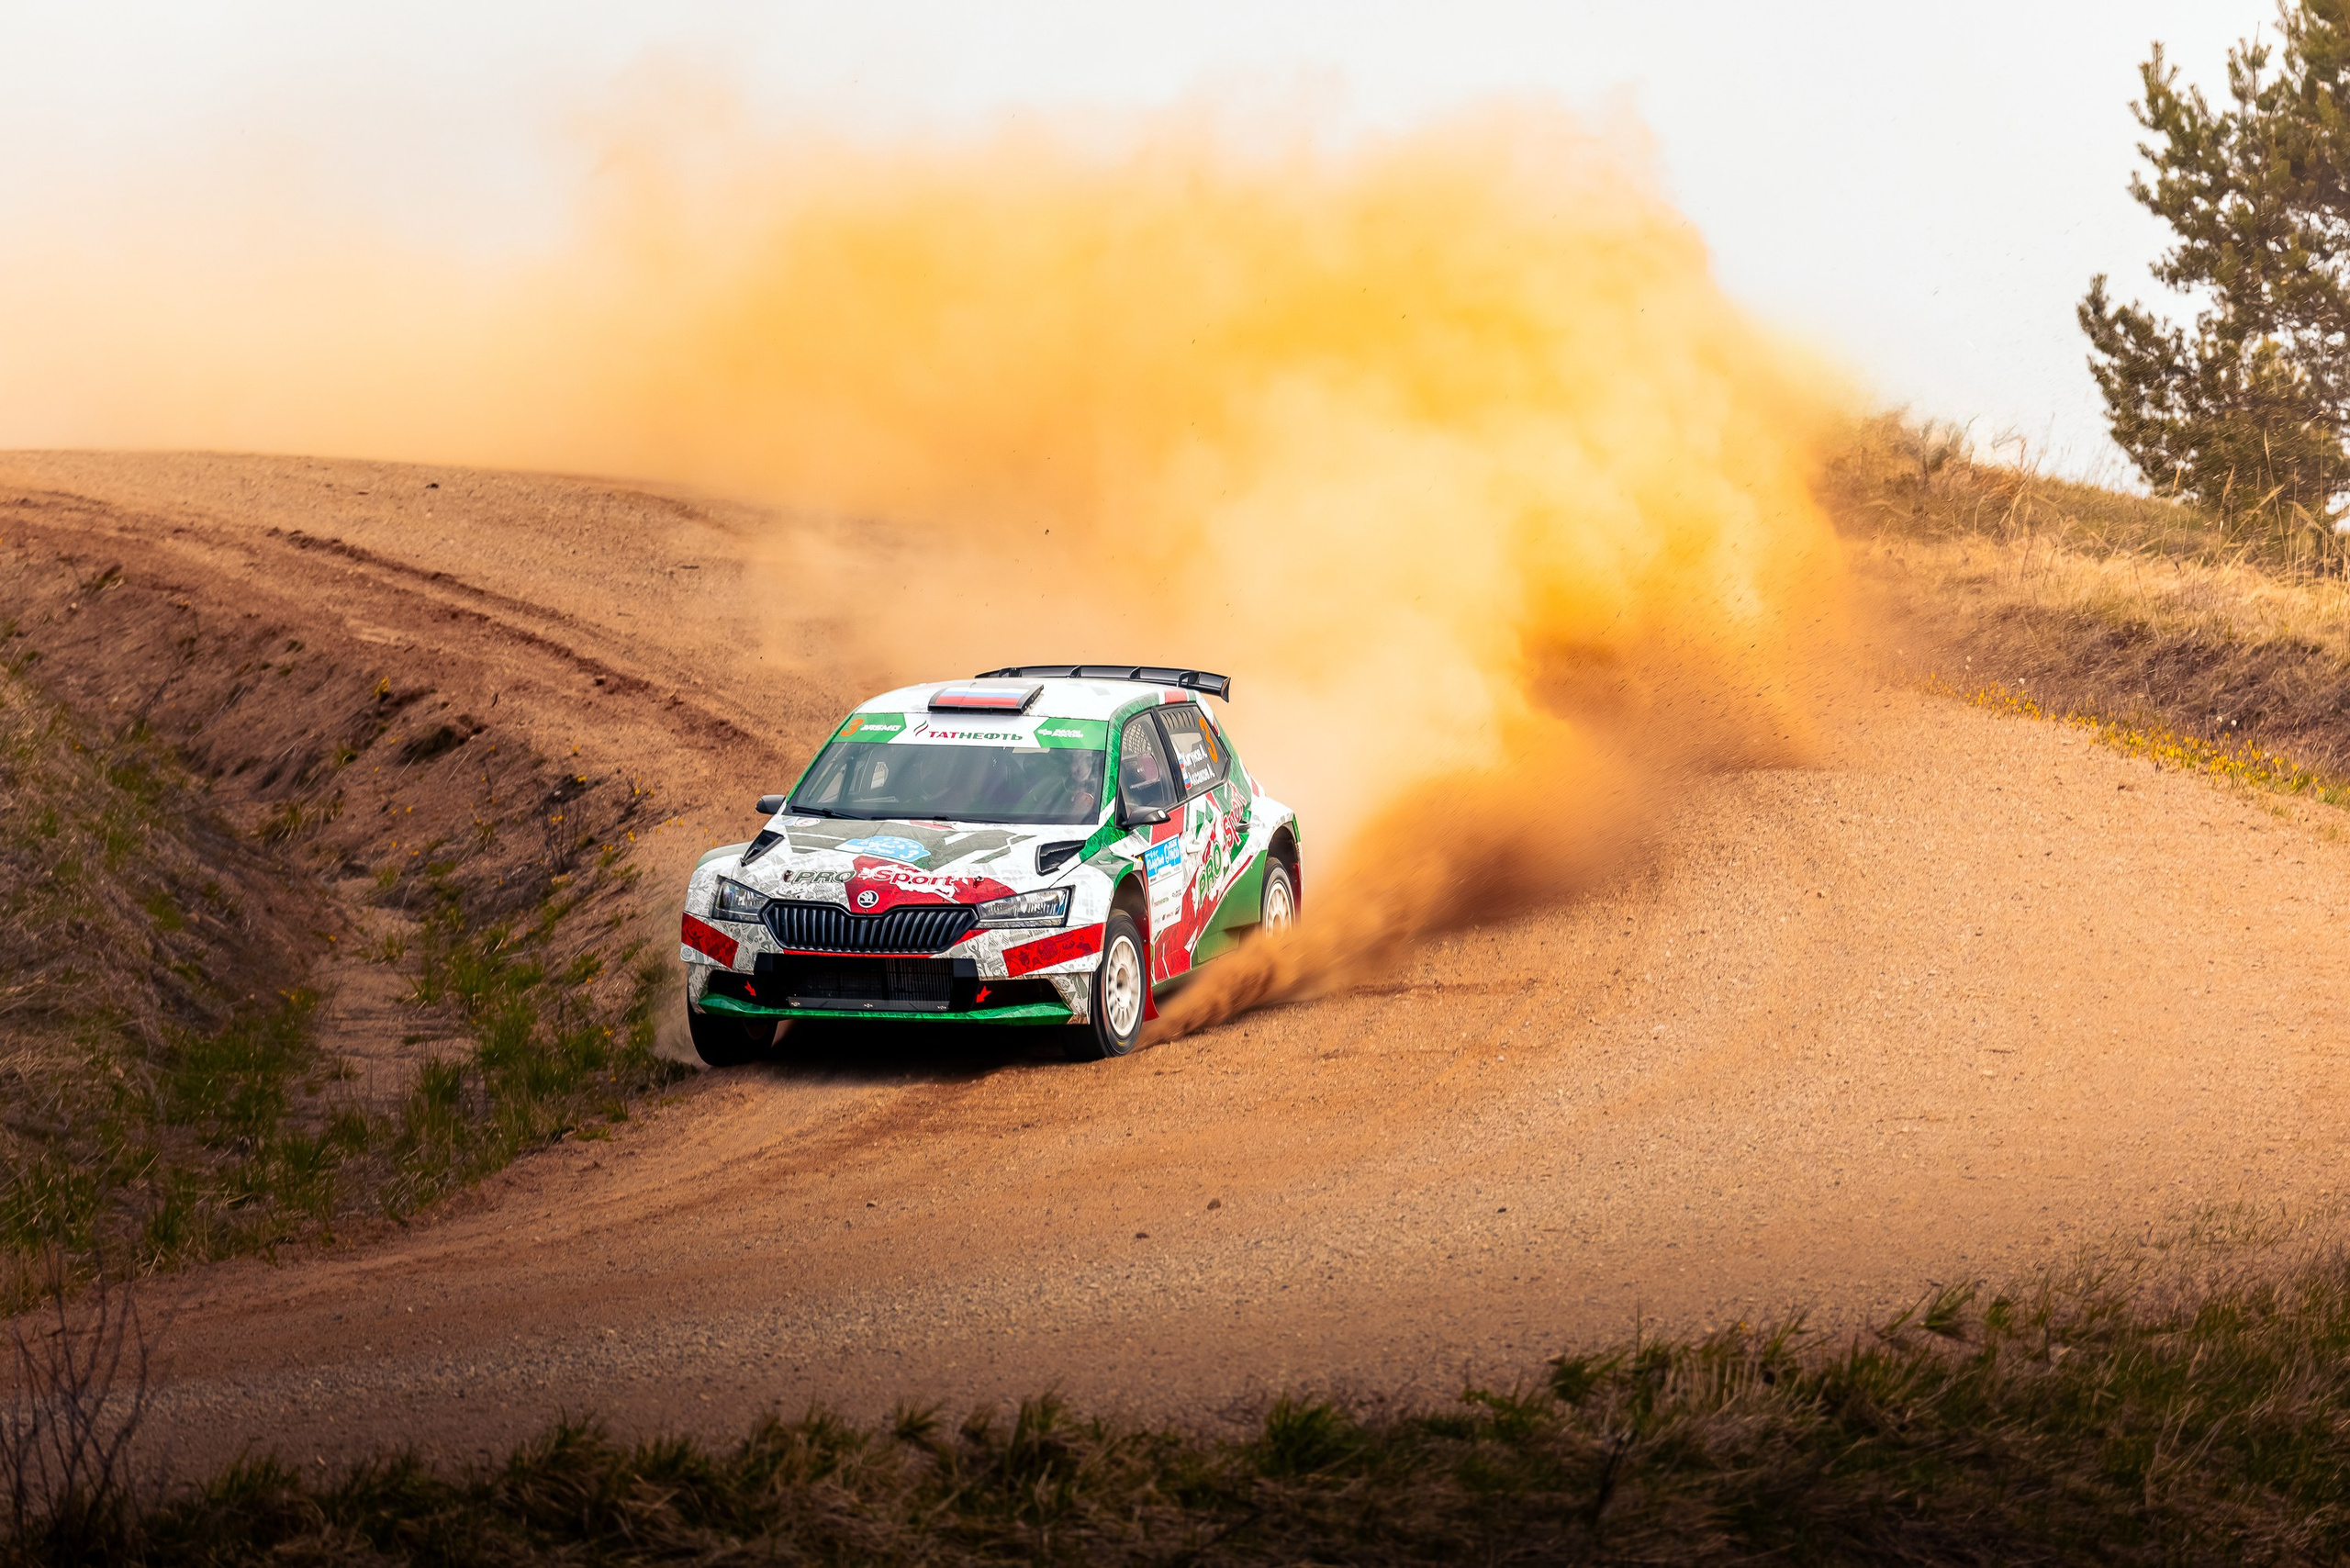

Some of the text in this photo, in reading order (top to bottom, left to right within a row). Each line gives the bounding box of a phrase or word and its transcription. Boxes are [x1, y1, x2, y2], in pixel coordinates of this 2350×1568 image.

[840, 718, 864, 737] 3
[928, 731, 1024, 741] ТАТНЕФТЬ
[1198, 716, 1218, 764] 3
[899, 849, 920, 859] 3
